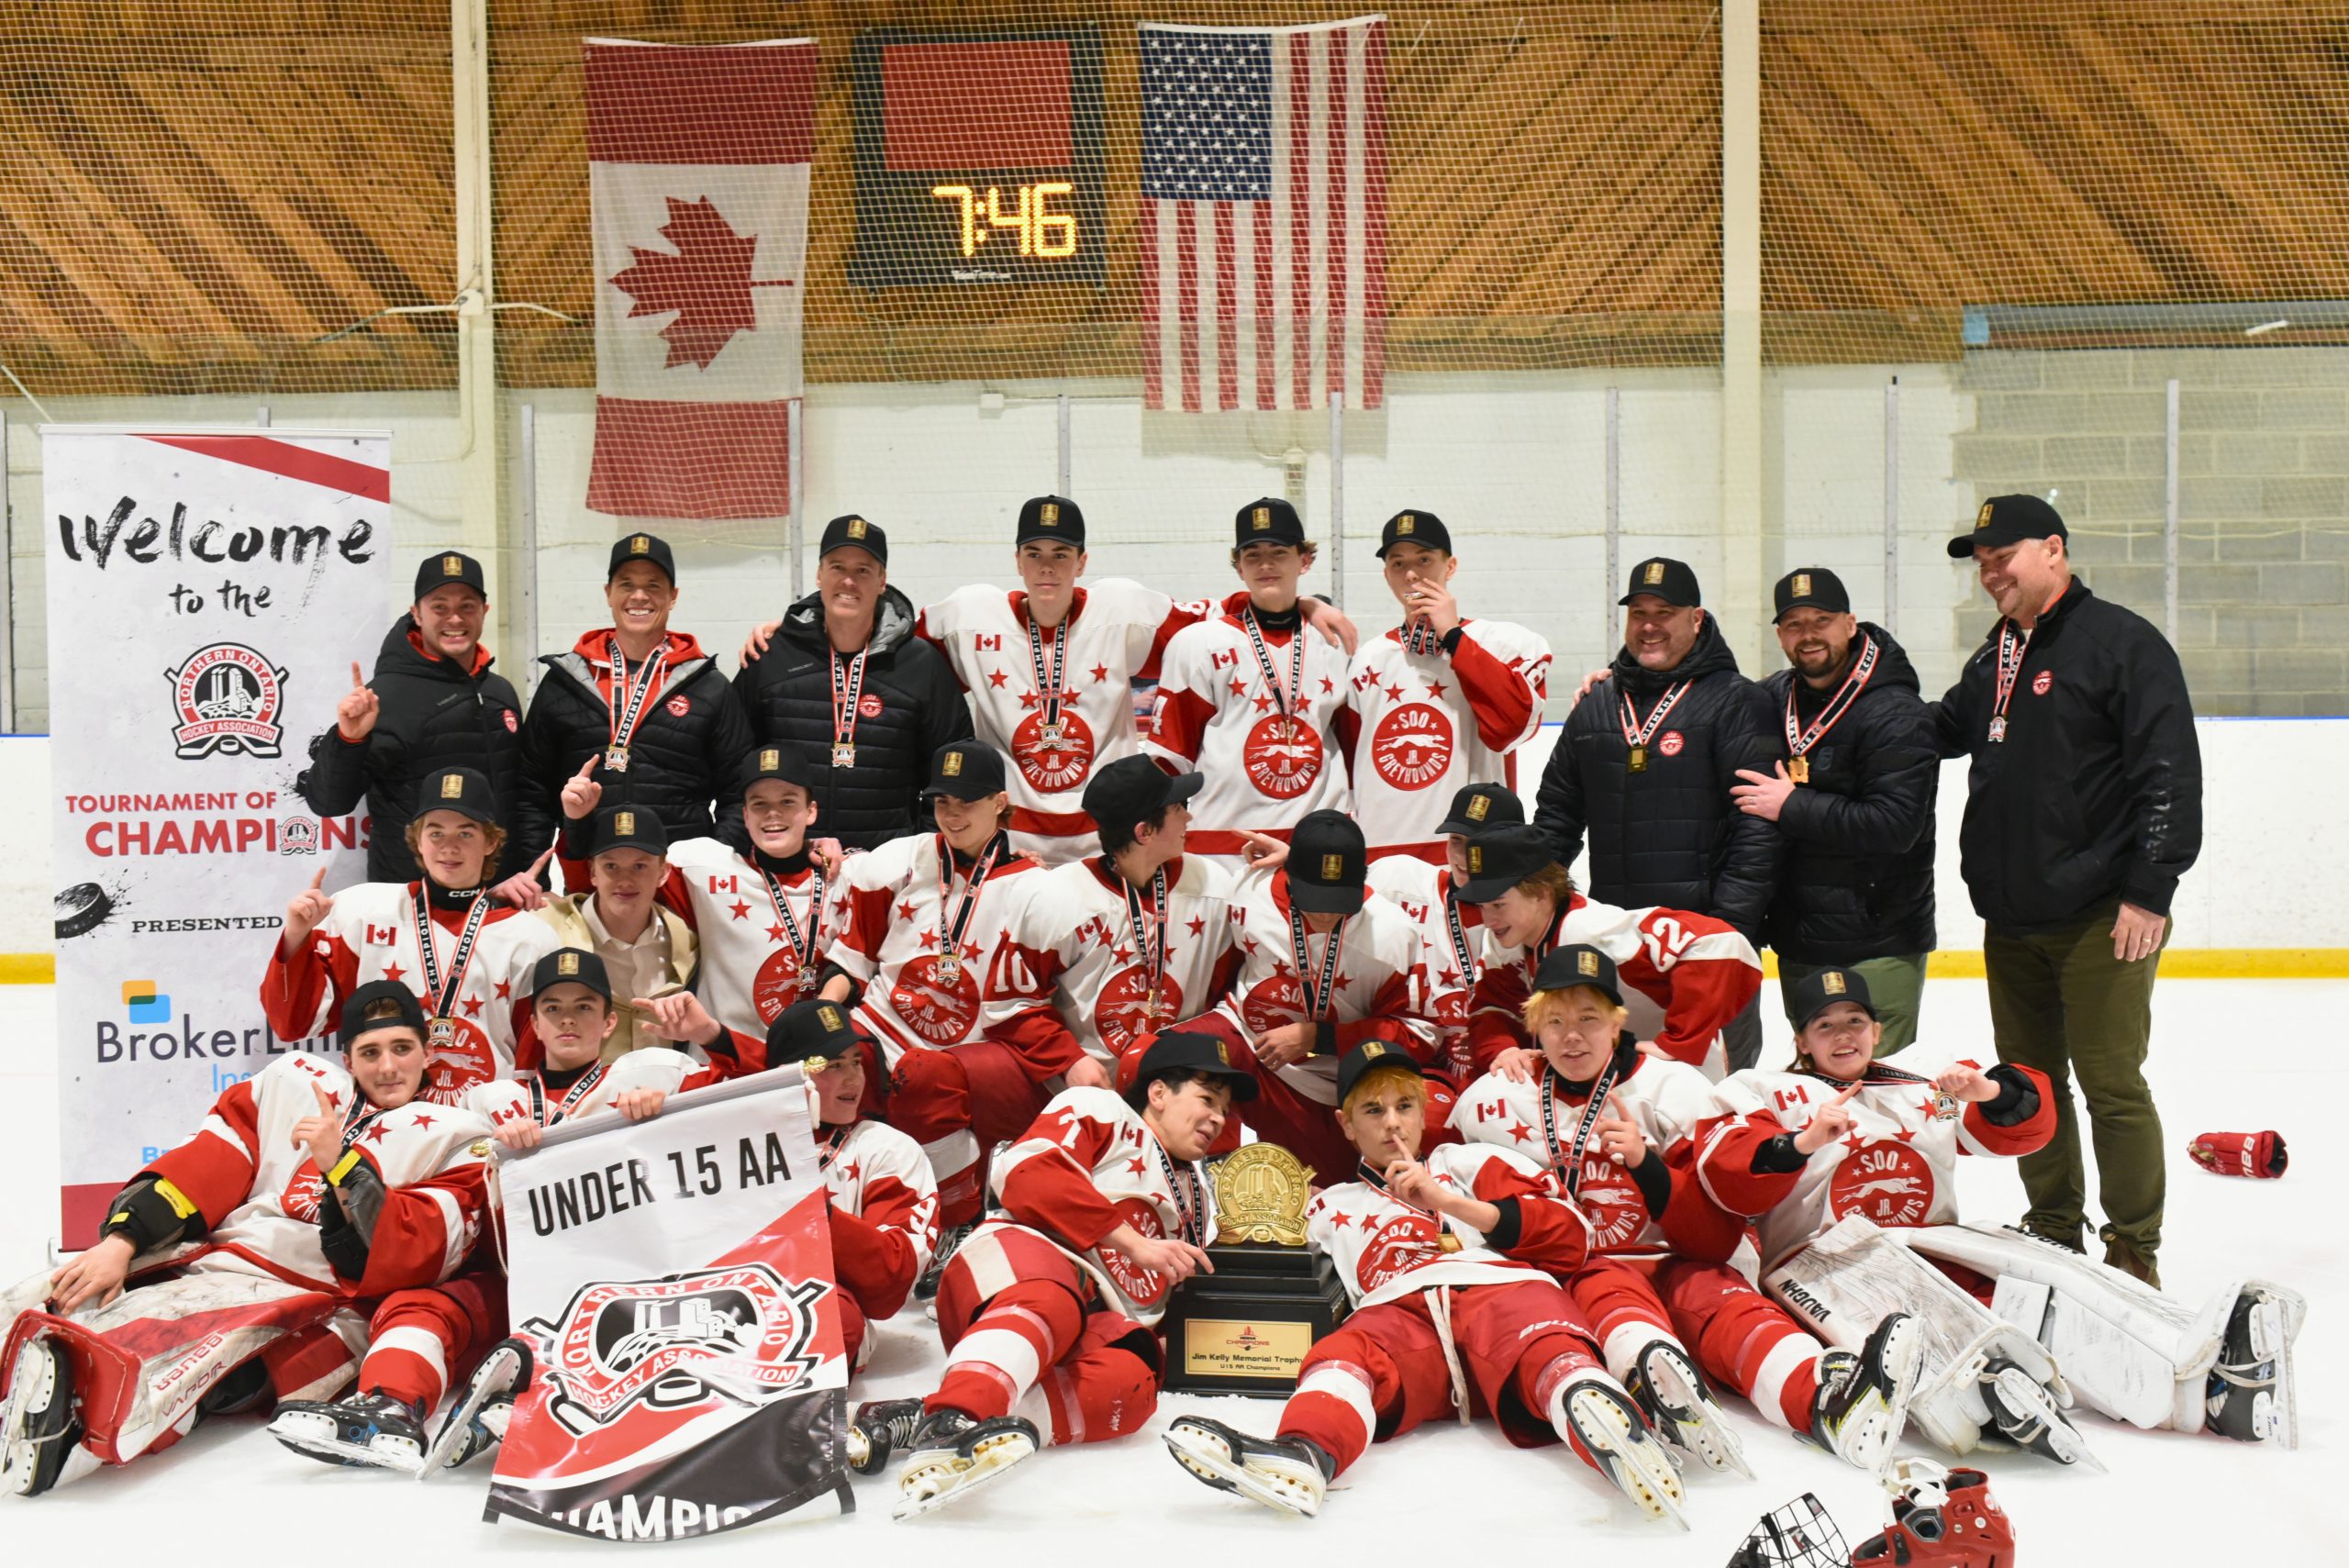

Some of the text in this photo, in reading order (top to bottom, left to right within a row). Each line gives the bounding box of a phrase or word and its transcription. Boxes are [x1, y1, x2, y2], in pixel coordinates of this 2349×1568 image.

[933, 183, 1076, 257] 7:46
[59, 495, 375, 602] Welcome
[168, 579, 273, 617] to the
[181, 650, 275, 712] NORTHERN ONTARIO
[181, 721, 275, 740] HOCKEY ASSOCIATION
[1398, 709, 1431, 729] SOO
[1021, 755, 1087, 788] GREYHOUNDS
[1378, 751, 1448, 784] GREYHOUNDS
[1406, 749, 1420, 765] JR.
[1251, 761, 1317, 793] GREYHOUNDS
[65, 791, 277, 814] TOURNAMENT OF
[448, 888, 481, 898] CCM
[131, 916, 284, 933] PRESENTED
[458, 897, 487, 961] CHAMPIONS
[417, 912, 438, 985] CHAMPIONS
[1450, 908, 1473, 981] CHAMPIONS
[994, 950, 1038, 994] 10
[1319, 933, 1340, 1006] CHAMPIONS
[895, 993, 964, 1040] GREYHOUNDS
[1575, 1077, 1610, 1151] CHAMPIONS
[1860, 1150, 1899, 1174] SOO
[528, 1132, 792, 1237] UNDER 15 AA
[1876, 1198, 1894, 1218] JR.
[1378, 1221, 1413, 1244] SOO
[1777, 1278, 1832, 1324] VAUGHN
[1209, 1353, 1230, 1362] Kelly
[1232, 1354, 1272, 1362] Memorial
[161, 1361, 228, 1418] VAPOR
[571, 1372, 645, 1410] HOCKEY
